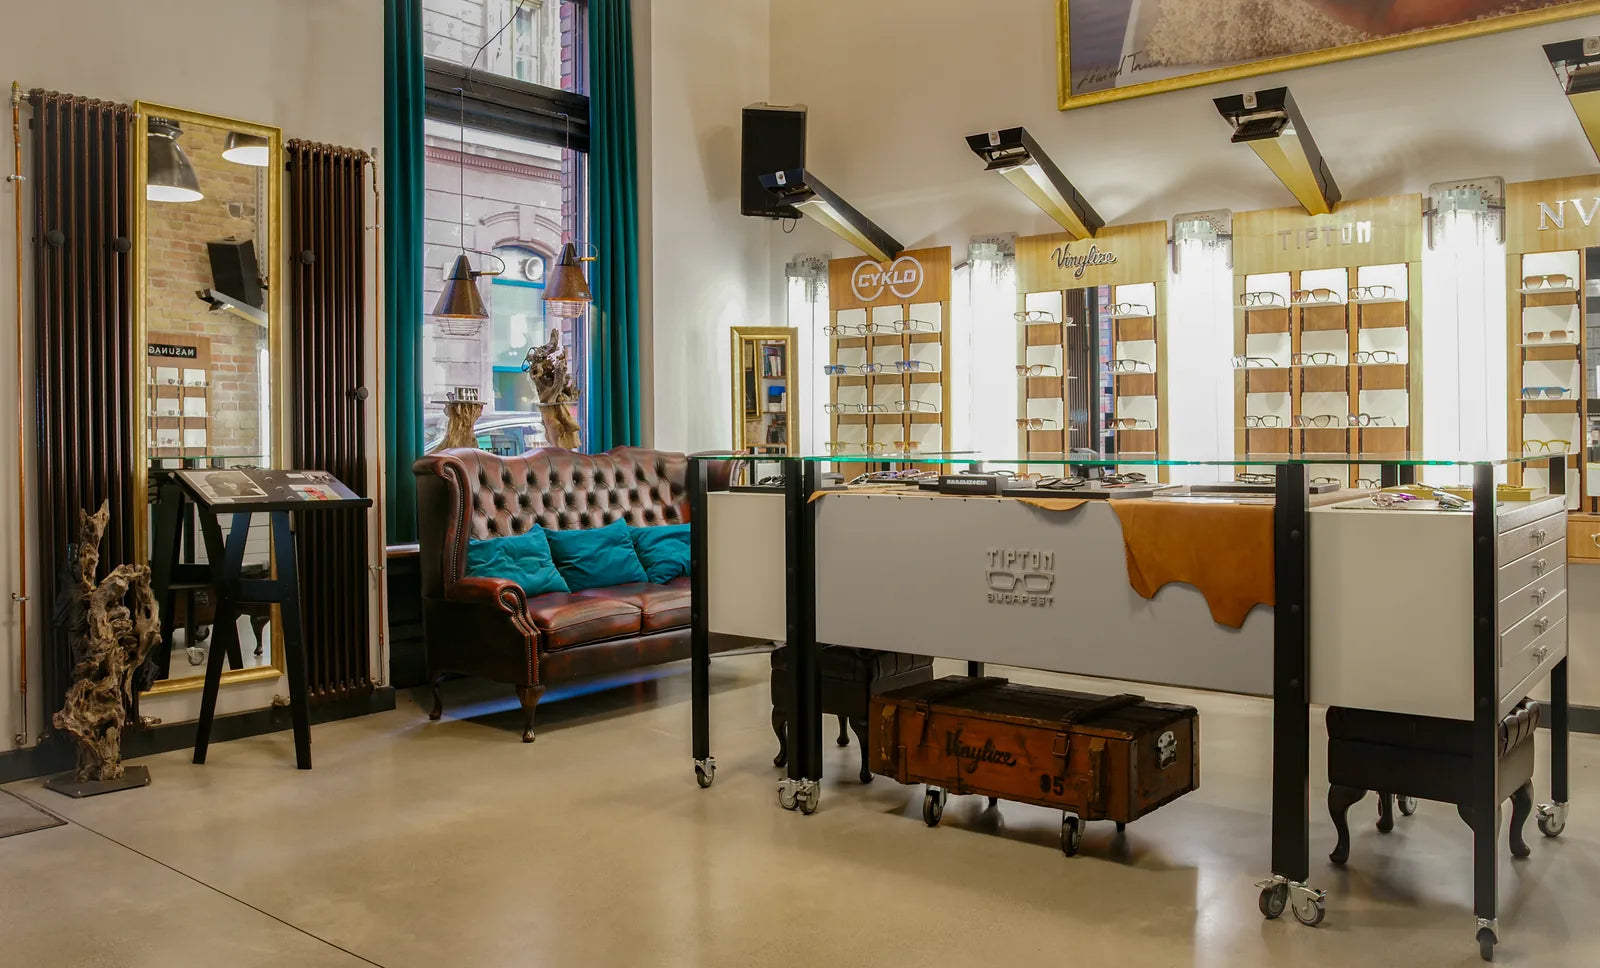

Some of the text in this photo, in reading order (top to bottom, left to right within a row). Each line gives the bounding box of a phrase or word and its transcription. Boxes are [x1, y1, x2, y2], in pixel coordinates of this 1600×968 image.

[1277, 220, 1372, 251] TIPTON
[1049, 242, 1118, 280] Vinylize
[857, 269, 917, 288] CYKLO
[985, 549, 1055, 571] TIPTON
[986, 592, 1055, 608] BUDAPEST
[944, 725, 1017, 774] Vinylize
